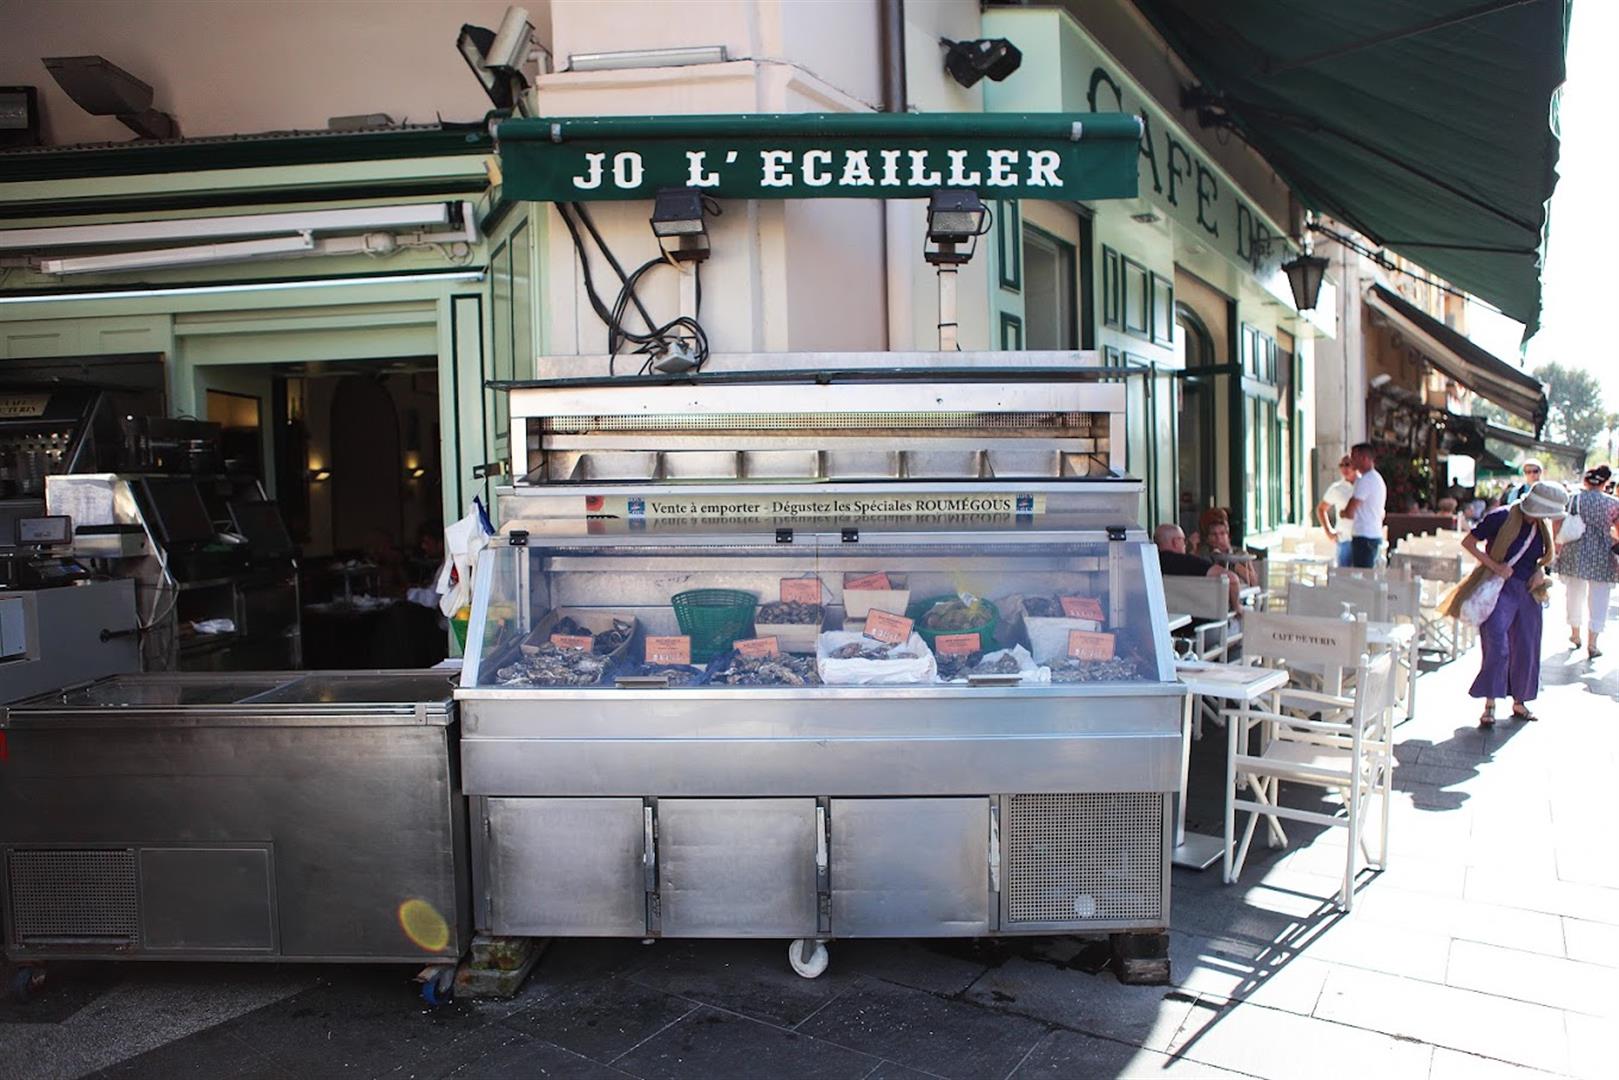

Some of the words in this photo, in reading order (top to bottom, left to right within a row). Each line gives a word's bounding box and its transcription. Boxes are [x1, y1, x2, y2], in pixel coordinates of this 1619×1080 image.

[573, 151, 646, 189] JO
[651, 502, 687, 514] Vente
[690, 501, 698, 514] à
[700, 502, 761, 516] emporter
[773, 500, 831, 516] Dégustez
[834, 500, 851, 512] les
[854, 500, 912, 515] Spéciales
[916, 497, 1011, 512] ROUMÉGOUS
[1309, 636, 1337, 646] TURIN
